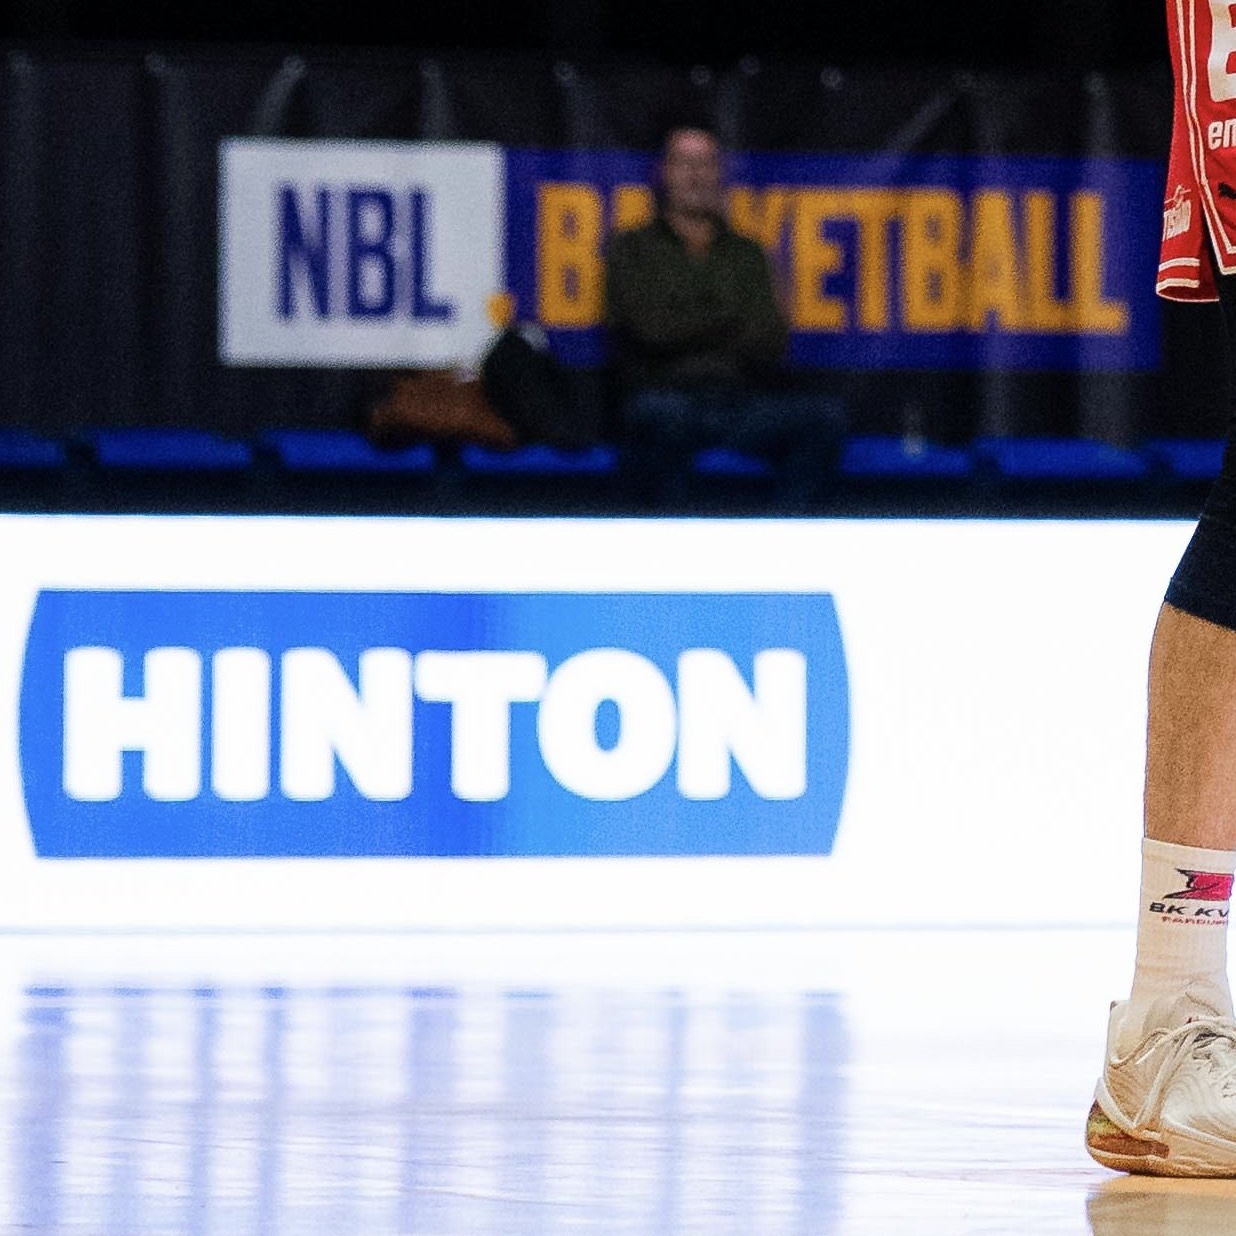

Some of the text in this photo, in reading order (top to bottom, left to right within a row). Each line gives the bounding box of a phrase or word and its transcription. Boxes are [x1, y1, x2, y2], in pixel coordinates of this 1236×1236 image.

[273, 183, 457, 324] NBL
[536, 181, 1129, 334] BETBALL
[62, 645, 807, 802] HINTON
[1149, 902, 1189, 916] BK
